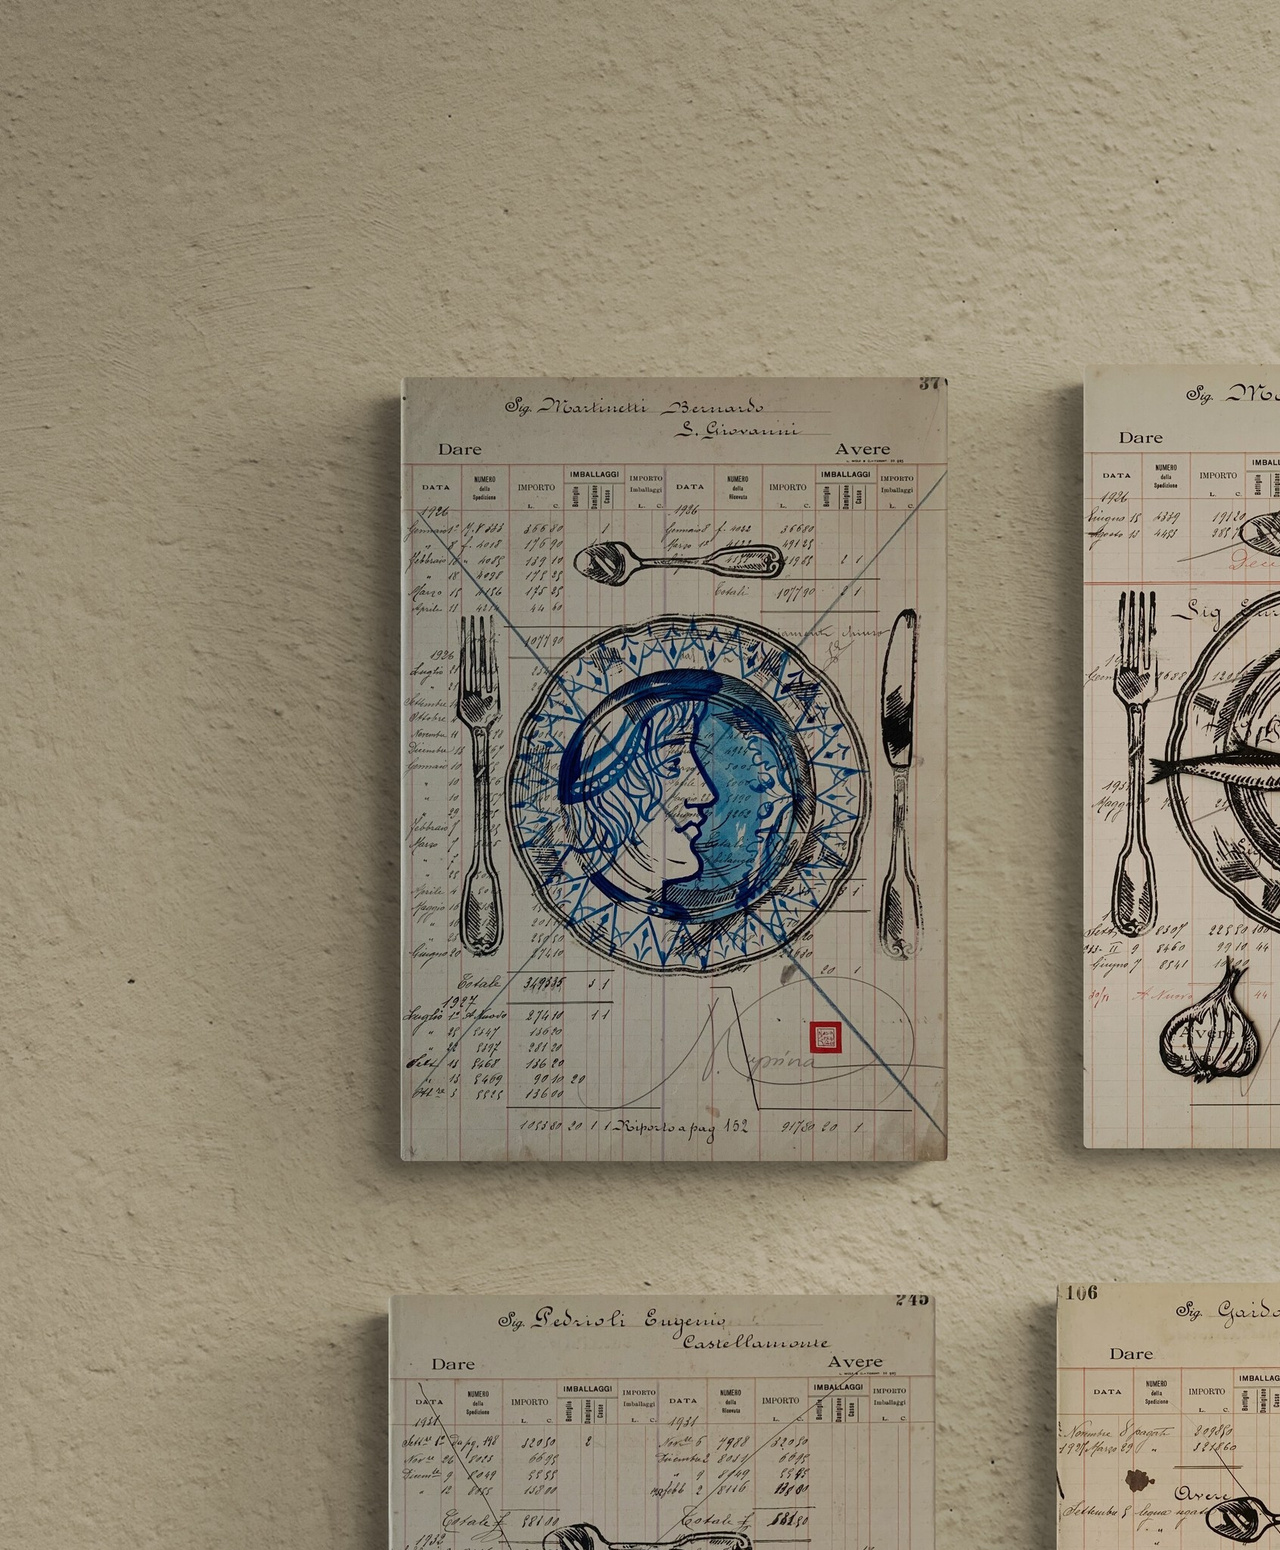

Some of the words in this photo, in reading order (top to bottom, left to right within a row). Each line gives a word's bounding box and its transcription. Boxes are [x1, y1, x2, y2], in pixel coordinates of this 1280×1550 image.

[919, 377, 940, 390] 37
[1186, 385, 1213, 405] Sig.
[505, 396, 532, 417] Sig.
[537, 397, 650, 414] Martinetti
[661, 397, 763, 415] Bernardo
[1119, 432, 1163, 443] Dare
[439, 443, 482, 455] Dare
[835, 443, 891, 455] Avere
[1065, 1285, 1098, 1300] 106
[1176, 1301, 1202, 1321] Sig.
[498, 1311, 525, 1332] Sig.
[531, 1306, 626, 1328] Pedrioli
[645, 1308, 726, 1339] Eugenio
[683, 1335, 832, 1349] Castellamonte
[1110, 1348, 1153, 1360] Dare
[432, 1358, 475, 1370] Dare
[828, 1356, 883, 1367] Avere
